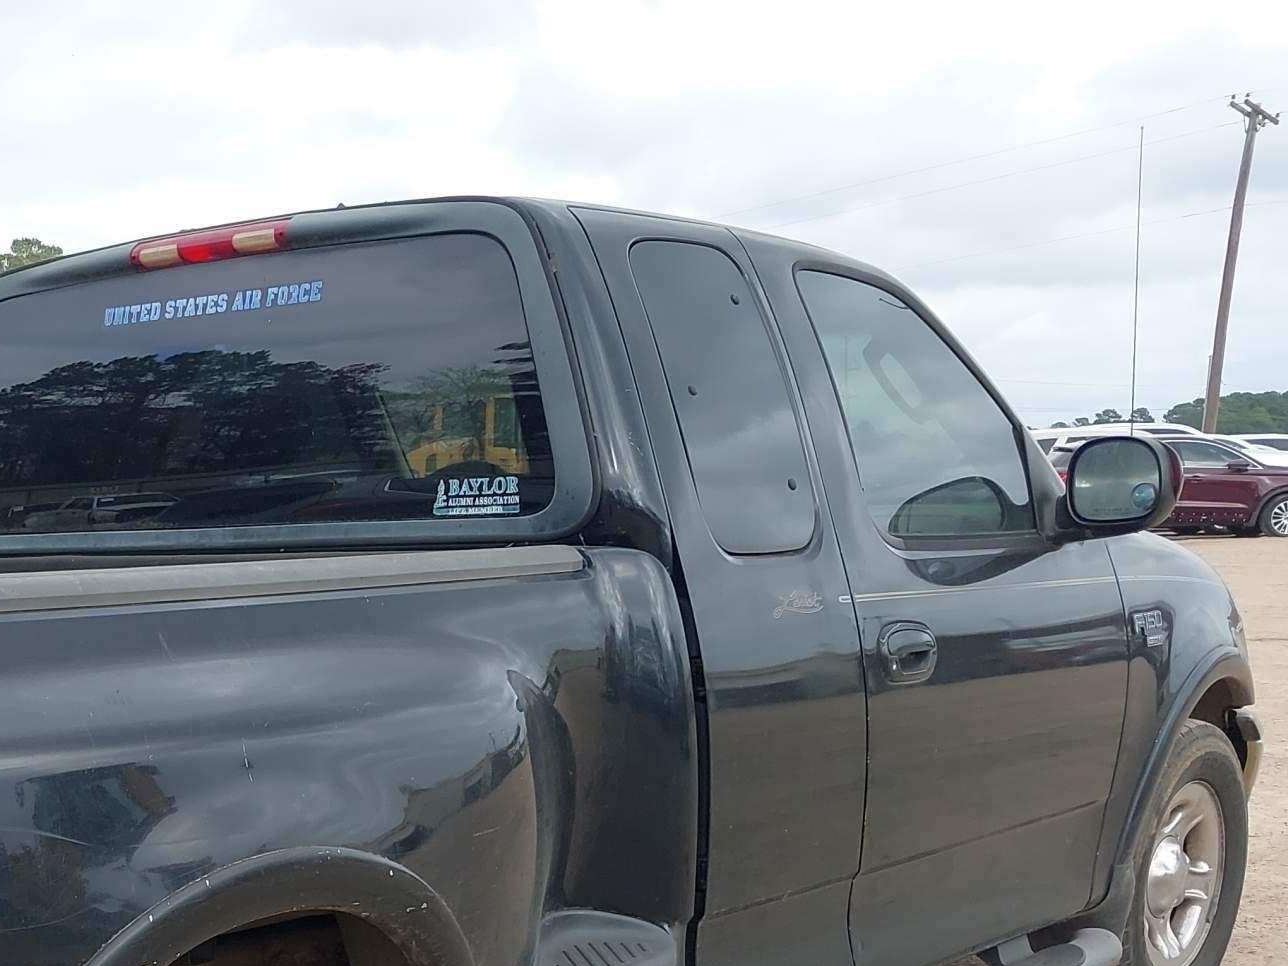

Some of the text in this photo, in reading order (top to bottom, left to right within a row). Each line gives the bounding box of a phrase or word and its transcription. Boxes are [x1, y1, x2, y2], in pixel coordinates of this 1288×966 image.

[104, 280, 324, 327] UNITED STATES AIR FORCE
[448, 476, 519, 496] BAYLOR
[448, 496, 520, 507] ALUMNI ASSOCIATION
